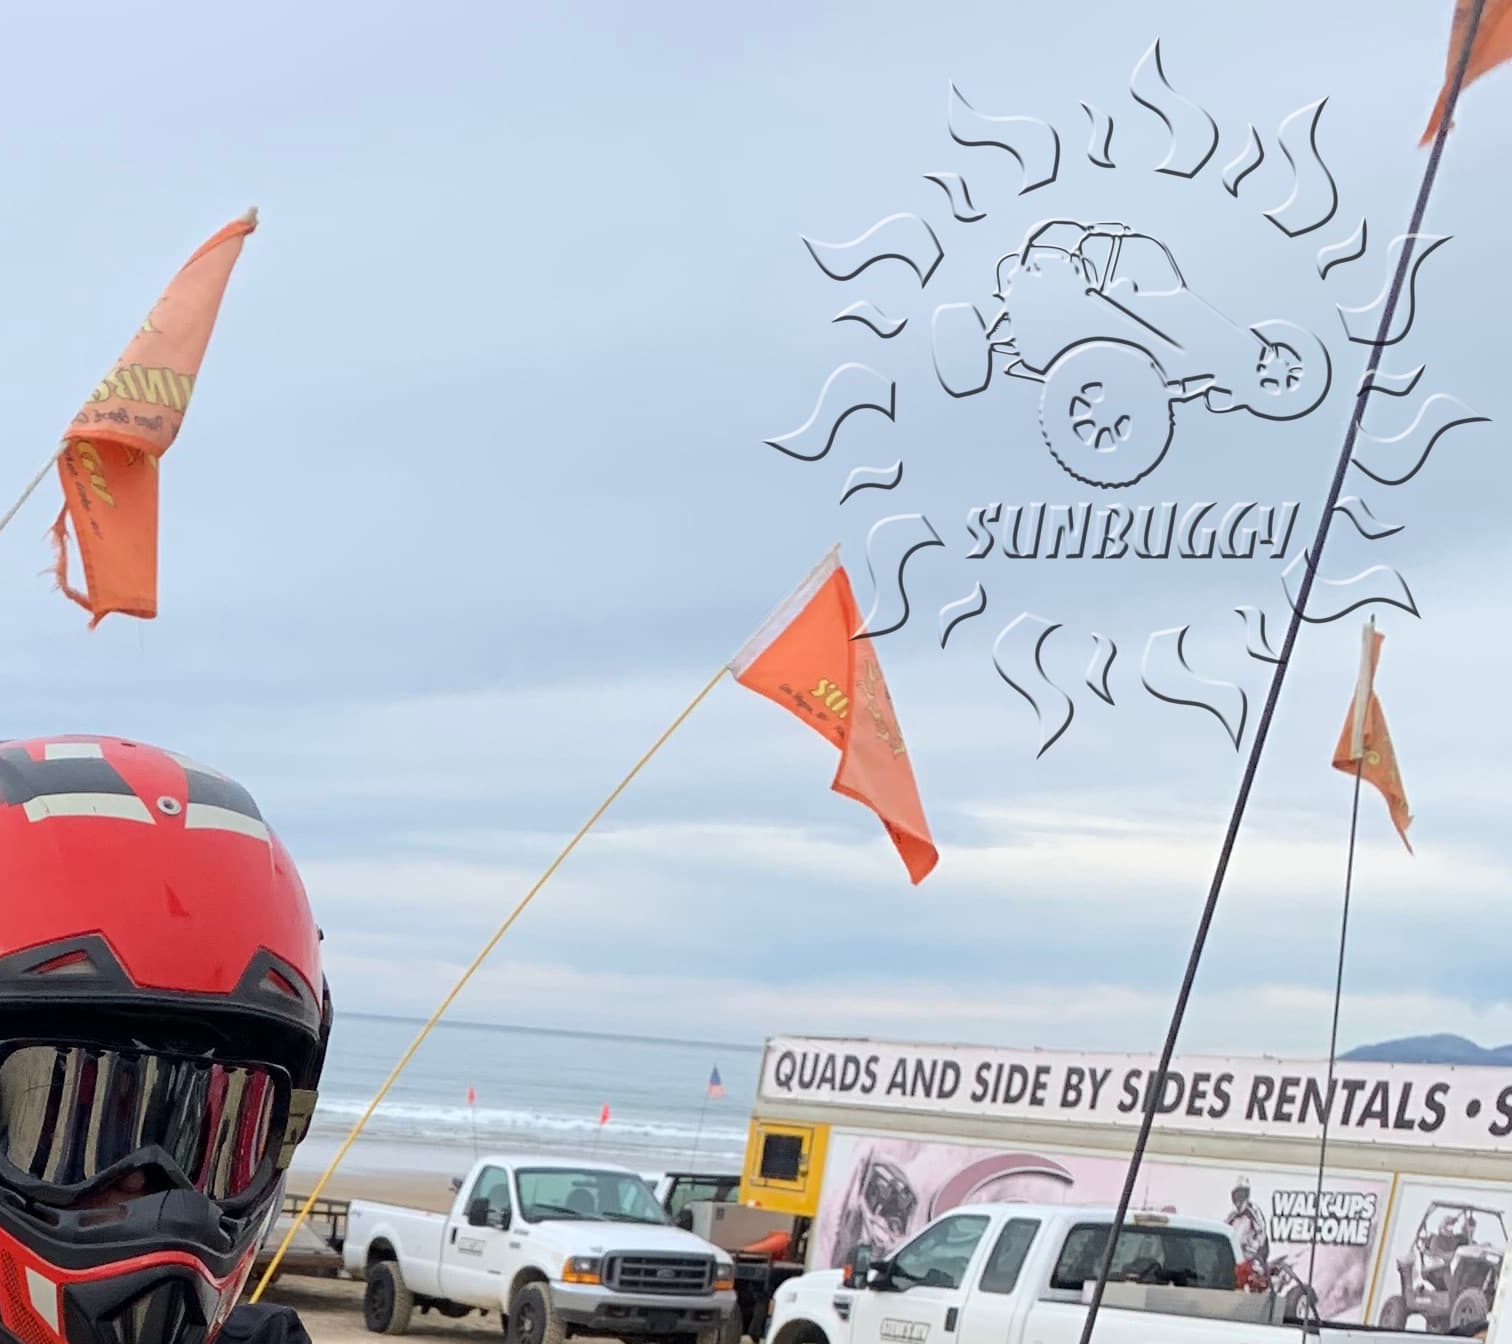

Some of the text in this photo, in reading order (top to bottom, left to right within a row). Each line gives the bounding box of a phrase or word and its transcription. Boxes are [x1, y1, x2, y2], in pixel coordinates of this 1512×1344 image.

[774, 1050, 880, 1093] QUADS
[886, 1057, 962, 1099] AND
[970, 1062, 1051, 1107] SIDE
[1060, 1066, 1112, 1111] BY
[1117, 1068, 1235, 1119] SIDES
[1245, 1074, 1451, 1133] RENTALS
[1272, 1190, 1378, 1220] WALK-UPS
